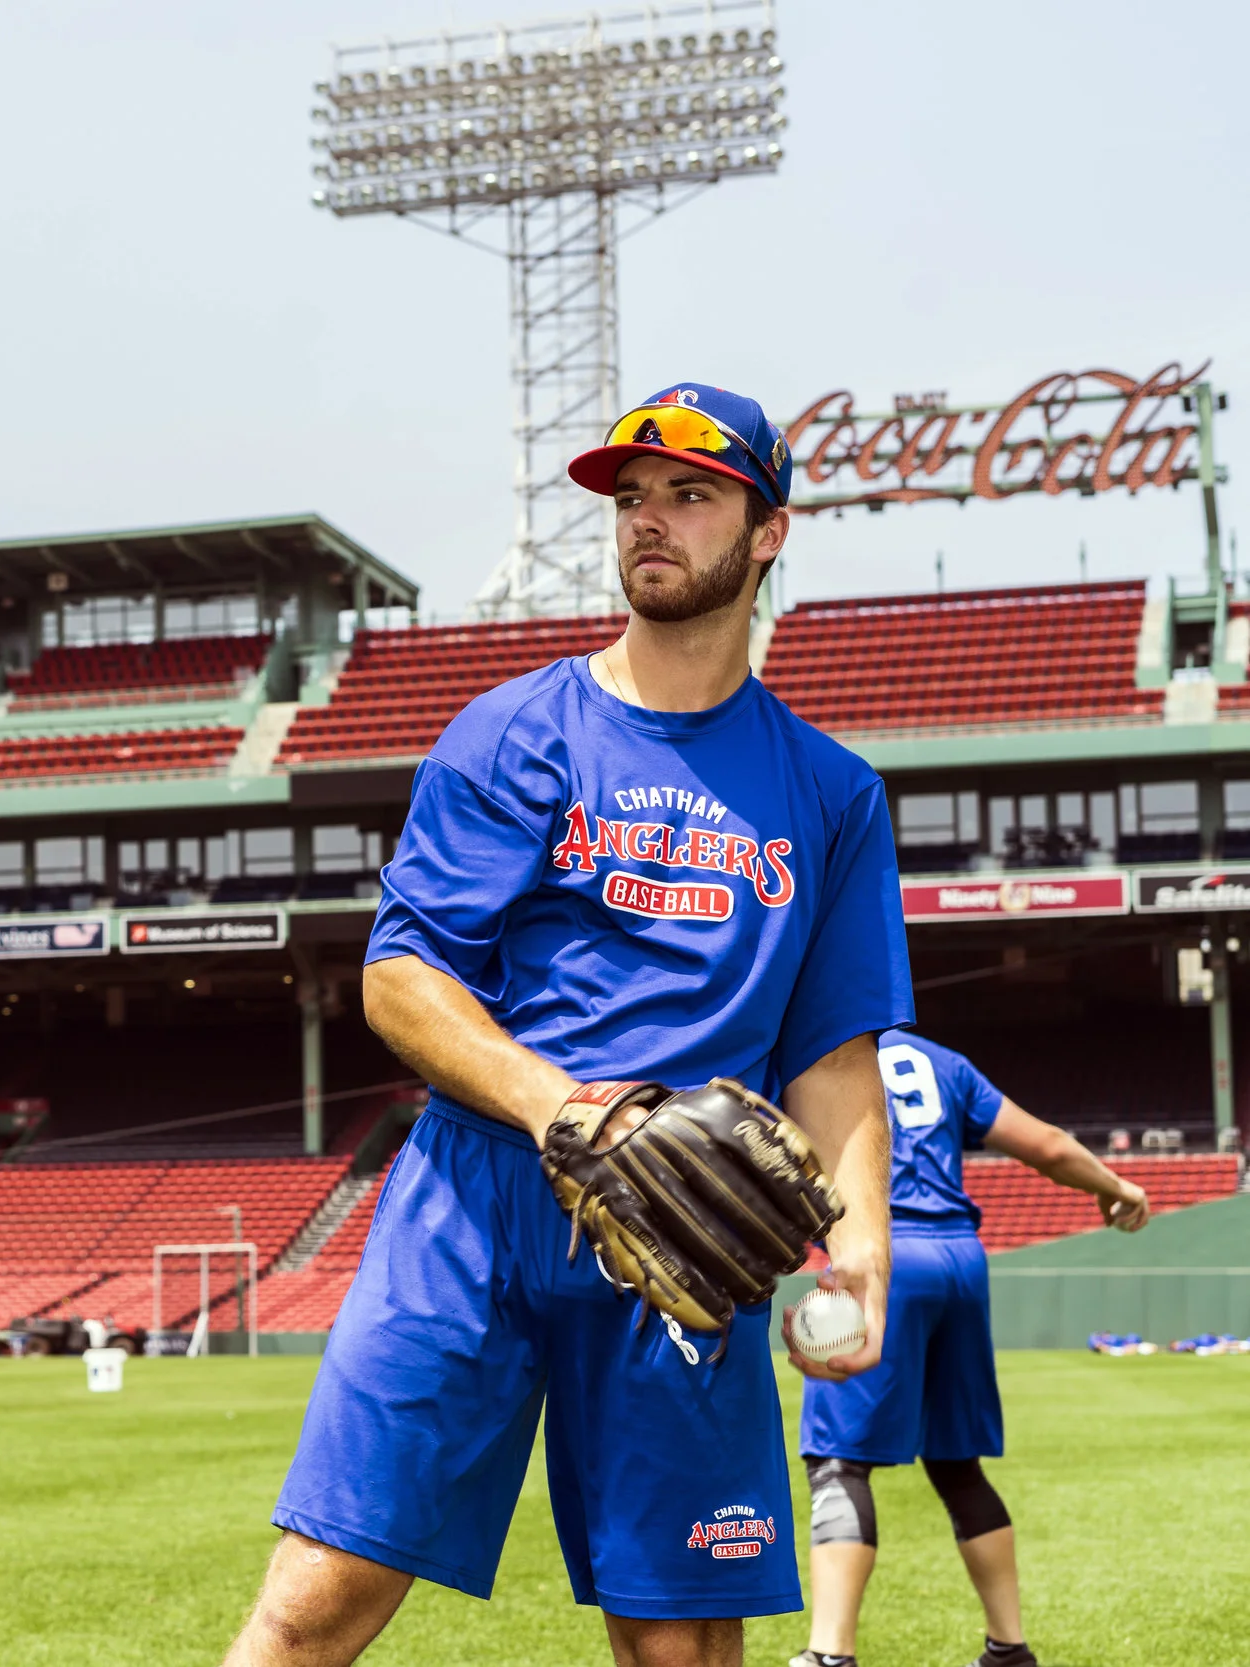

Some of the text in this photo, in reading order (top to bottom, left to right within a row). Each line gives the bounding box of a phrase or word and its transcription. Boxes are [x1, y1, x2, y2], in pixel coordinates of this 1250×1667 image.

[787, 357, 1212, 513] Coca-Cola
[614, 786, 727, 824] CHATHAM
[553, 801, 794, 907] ANGLERS
[613, 879, 723, 914] BASEBALL
[1, 928, 49, 949] vines
[713, 1505, 756, 1520] CHATHAM
[687, 1516, 777, 1549] ANGLERS
[716, 1546, 758, 1556] BASEBALL
